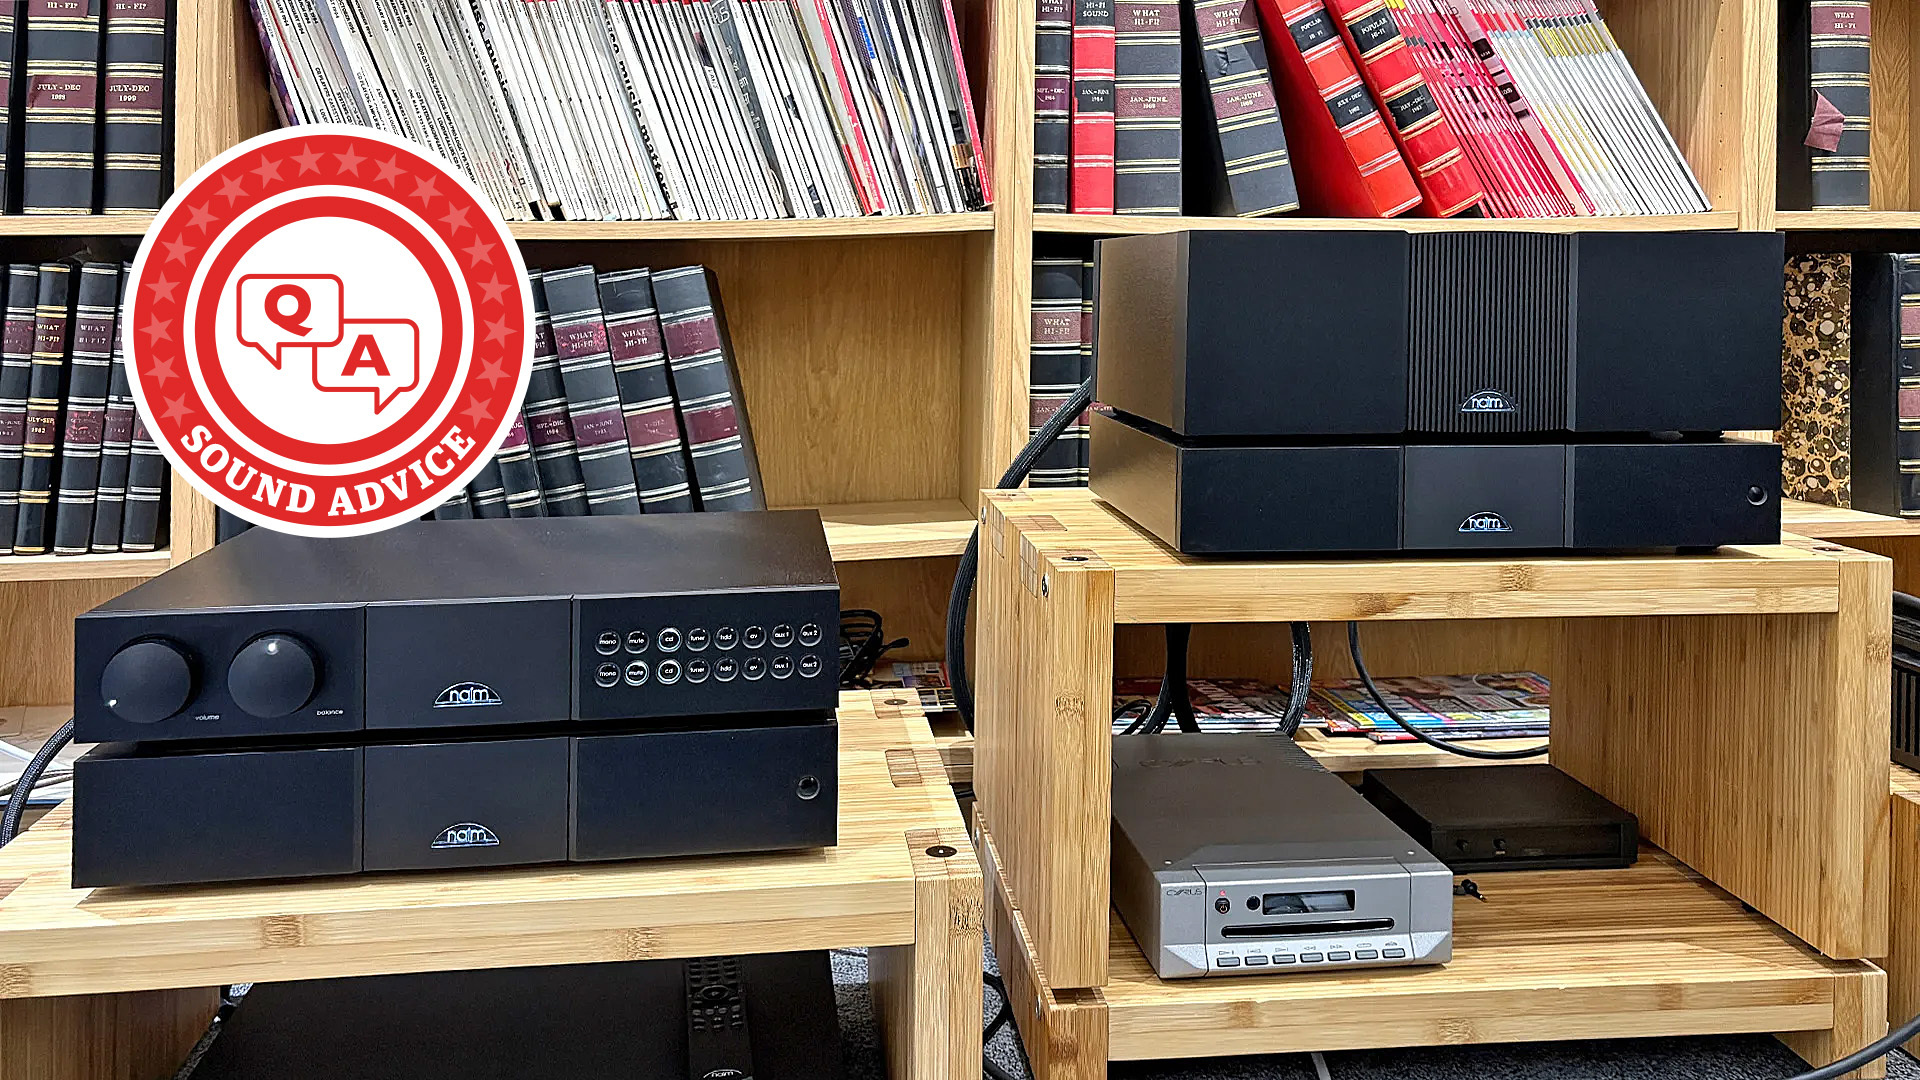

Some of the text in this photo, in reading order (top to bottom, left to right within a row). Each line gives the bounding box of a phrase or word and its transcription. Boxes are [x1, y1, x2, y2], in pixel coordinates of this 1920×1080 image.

[1214, 9, 1239, 19] WHAT
[1361, 17, 1388, 35] POPULAR
[1044, 318, 1071, 326] WHAT
[80, 324, 106, 332] WHAT
[622, 328, 646, 338] WHAT
[569, 331, 594, 341] WHAT
